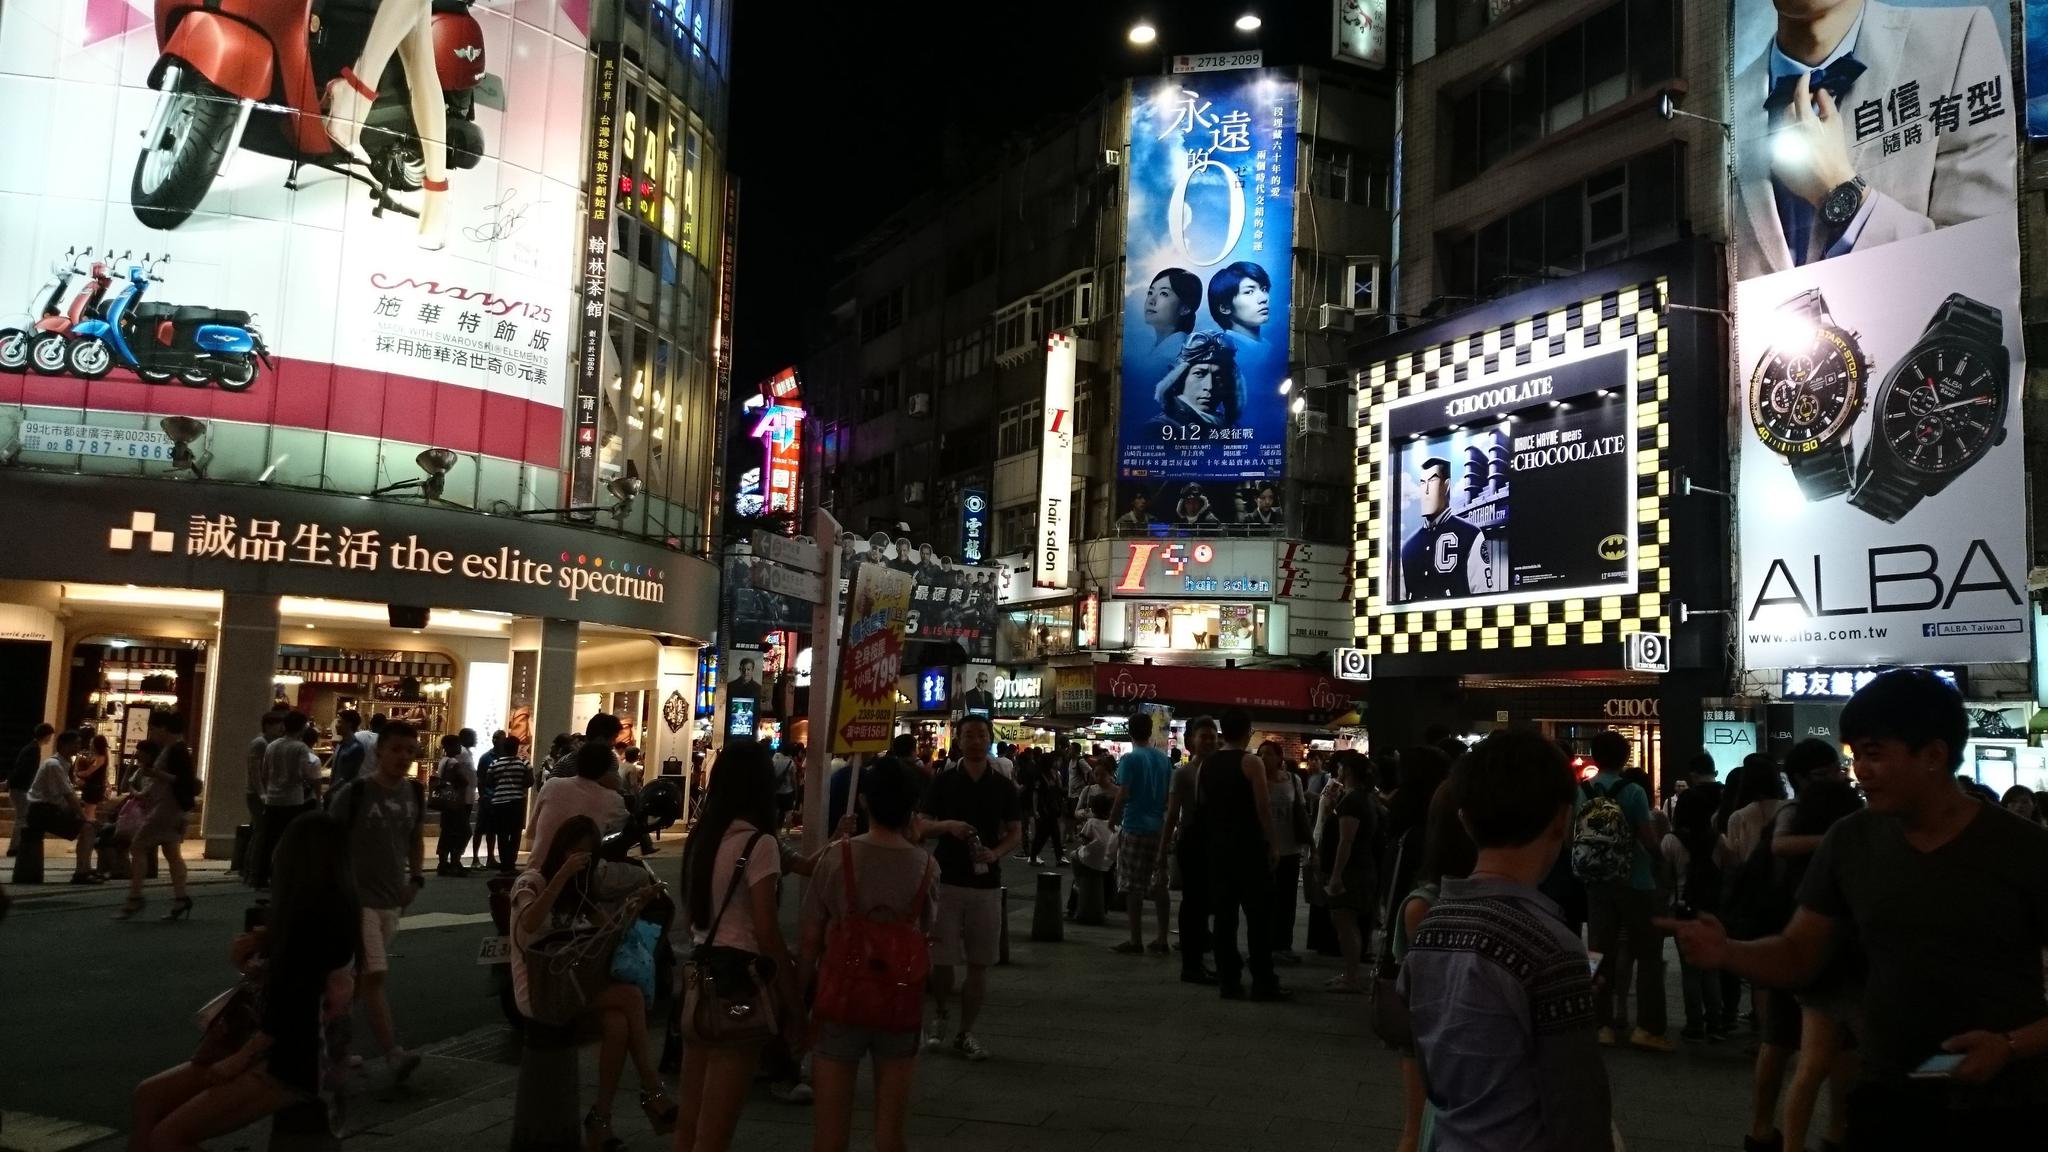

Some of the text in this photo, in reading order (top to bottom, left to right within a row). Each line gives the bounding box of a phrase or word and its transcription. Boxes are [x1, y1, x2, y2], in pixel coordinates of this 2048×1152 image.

[1197, 53, 1260, 68] 2718-2099
[1854, 79, 1922, 141] 自信
[1882, 75, 2005, 157] 隨時 有型
[1270, 97, 1285, 198] 一段埋藏六十年的愛
[586, 235, 607, 319] 翰林茶館
[373, 295, 552, 352] 施華特飾版
[521, 302, 553, 323] 125
[409, 326, 433, 338] WITH
[503, 344, 549, 366] ELEMENTS
[375, 334, 548, 385] 採用施華洛世奇®元素
[579, 397, 596, 458] 請上4樓
[1162, 424, 1254, 441] 9.12 為愛征戰
[1757, 426, 1770, 440] 40
[1803, 440, 1819, 452] 30
[1468, 502, 1496, 525] GOTHAM
[964, 517, 982, 565] 雪龍
[1045, 497, 1062, 571] hair salon
[187, 513, 666, 603] 誠品生活 the eslite spectrum
[1435, 533, 1459, 574] C
[1184, 576, 1270, 592] hair salon
[1748, 539, 2024, 622] ALBA
[914, 585, 981, 604] 最硬爽片
[904, 610, 921, 634] 3
[1943, 624, 2006, 633] ALBA Taiwan
[1748, 626, 1888, 644] www.alba.com.tw
[1004, 677, 1042, 698] TOUGH
[1704, 710, 1736, 721] 友鐘錶
[1000, 726, 1018, 741] Sale
[1705, 728, 1751, 746] LBA
[1807, 726, 1831, 736] ALBA
